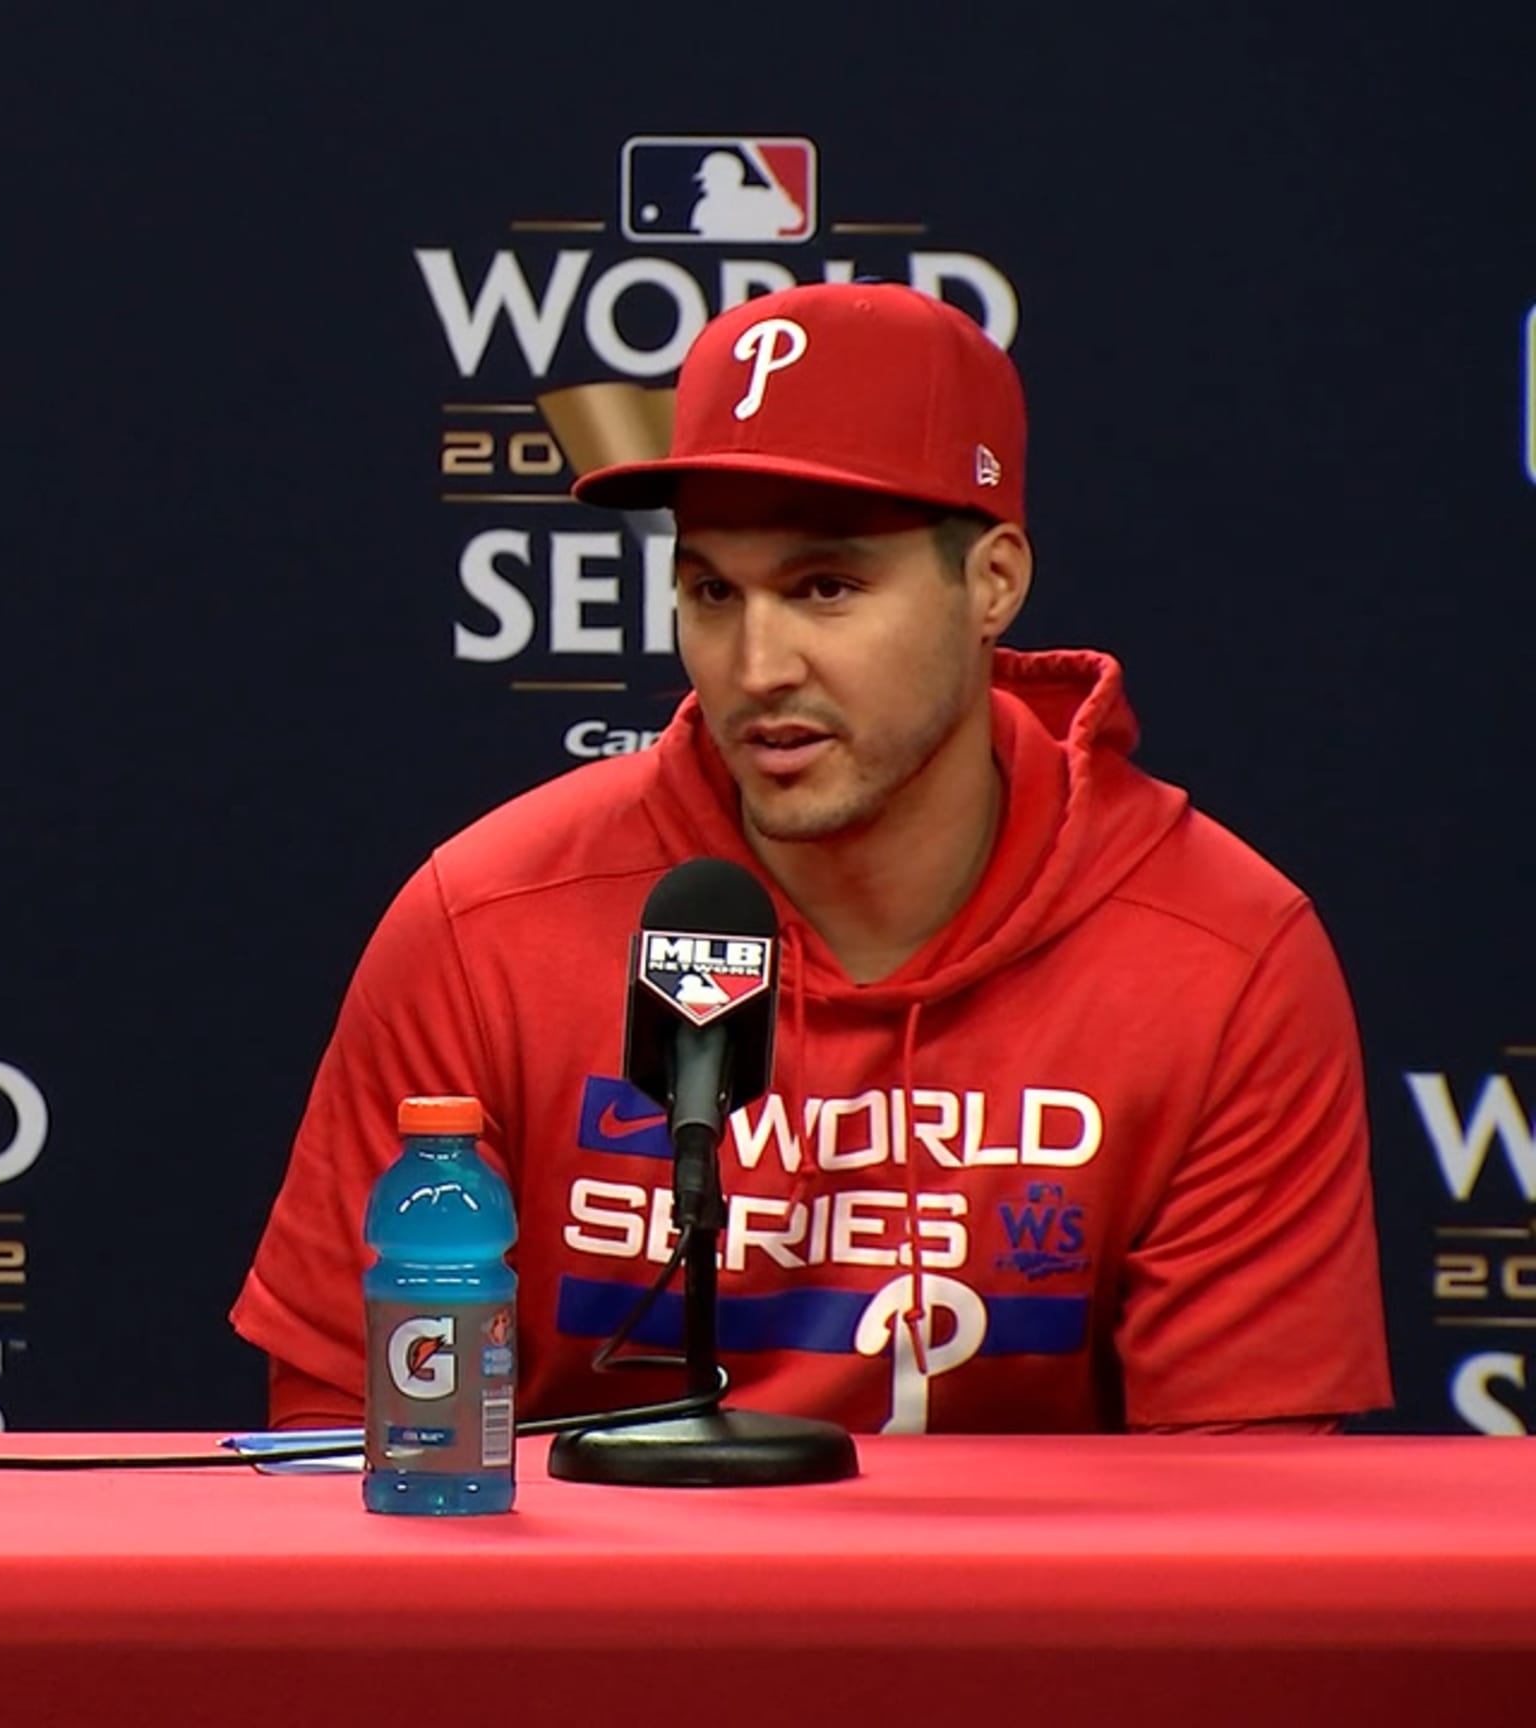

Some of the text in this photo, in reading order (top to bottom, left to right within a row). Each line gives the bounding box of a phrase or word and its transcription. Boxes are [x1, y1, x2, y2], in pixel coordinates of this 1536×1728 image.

[414, 248, 1020, 379] WOD
[733, 318, 808, 420] P
[442, 430, 563, 475] 20
[650, 937, 764, 967] MLB
[729, 1088, 1103, 1173] WORLD
[563, 1177, 968, 1271] SERIES
[999, 1203, 1084, 1253] WS
[388, 1315, 456, 1400] G
[854, 1272, 988, 1434] P
